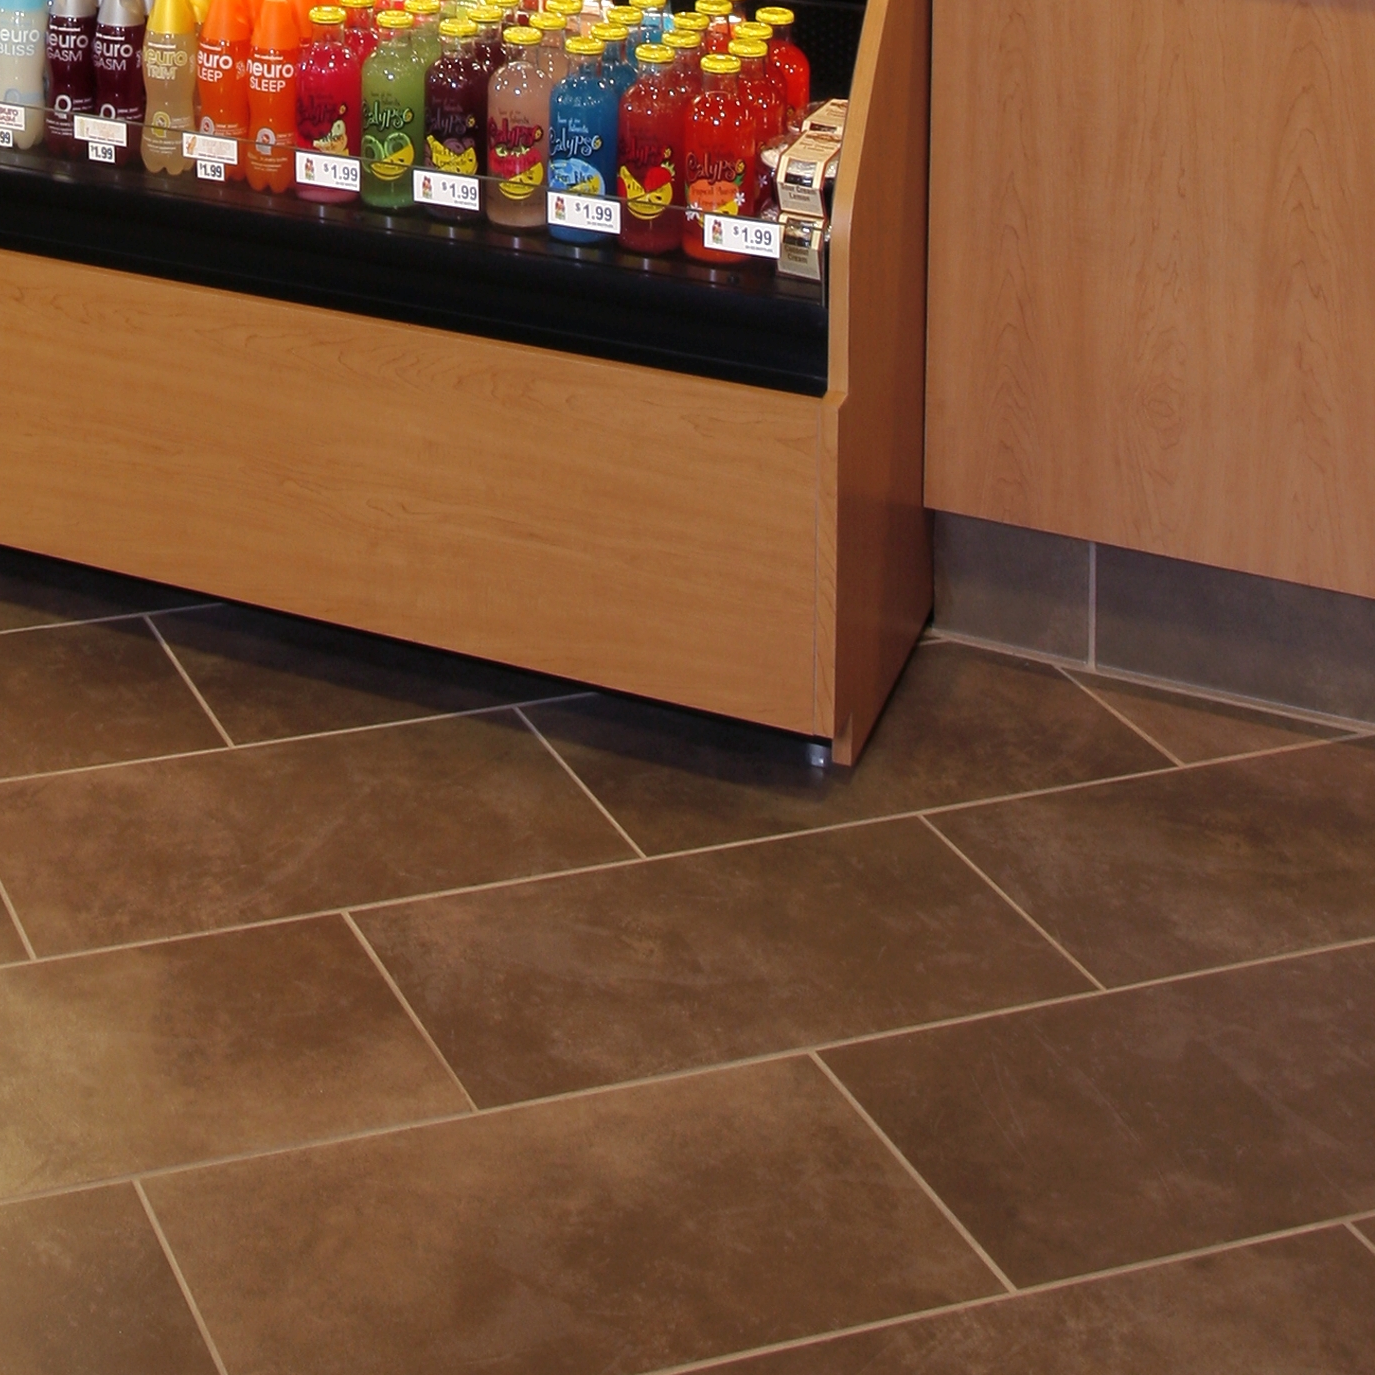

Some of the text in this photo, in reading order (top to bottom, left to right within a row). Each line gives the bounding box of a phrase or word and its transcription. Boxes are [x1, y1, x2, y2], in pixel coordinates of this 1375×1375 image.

[47, 47, 83, 62] GASM
[94, 40, 133, 58] euro
[197, 50, 233, 70] euro
[146, 64, 178, 80] TRIM
[197, 68, 223, 83] LEEP
[249, 76, 286, 92] SLEEP
[323, 162, 358, 182] $1.99
[441, 181, 477, 201] $1.99
[789, 192, 811, 201] Lemon
[575, 202, 613, 223] $1.99
[733, 225, 773, 246] $1.99
